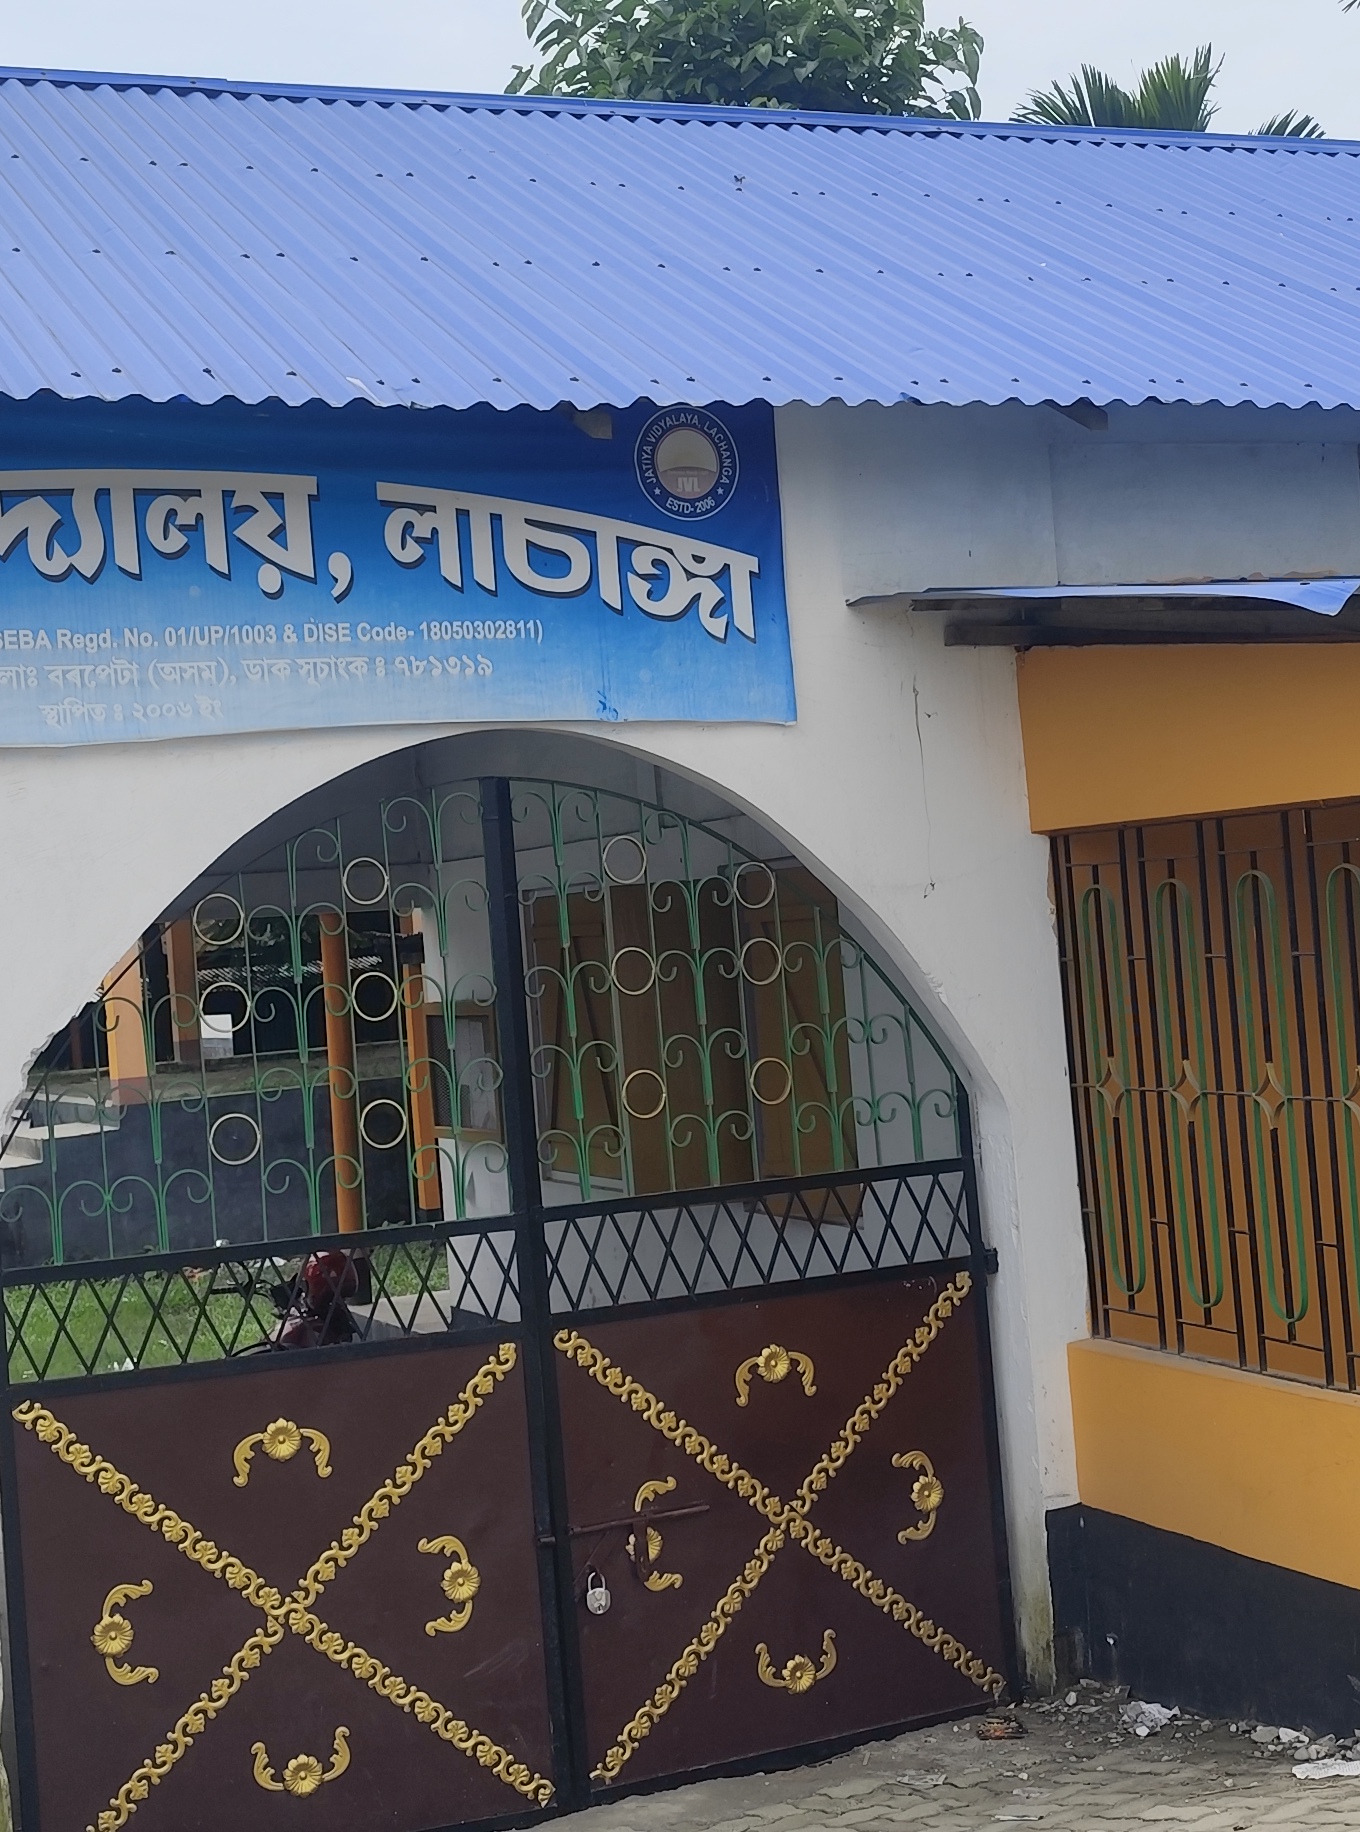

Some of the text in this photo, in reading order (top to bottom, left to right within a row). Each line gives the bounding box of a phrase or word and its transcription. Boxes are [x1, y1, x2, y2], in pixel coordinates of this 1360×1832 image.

[642, 413, 732, 484] JATIYA VIDYALAYA, LACHANGA
[676, 476, 701, 492] JVL
[695, 497, 716, 513] 2006
[376, 480, 760, 643] লাচাঙ্গা
[56, 626, 119, 654] Regd.
[124, 626, 160, 650] No.
[164, 623, 277, 649] 01/UP/1003
[282, 622, 300, 644] &
[303, 621, 352, 644] DISE
[356, 620, 415, 643] Code-
[419, 618, 544, 645] 18050302811)
[242, 656, 292, 684] ডাক
[394, 654, 495, 679] ৭৮১৩১৯
